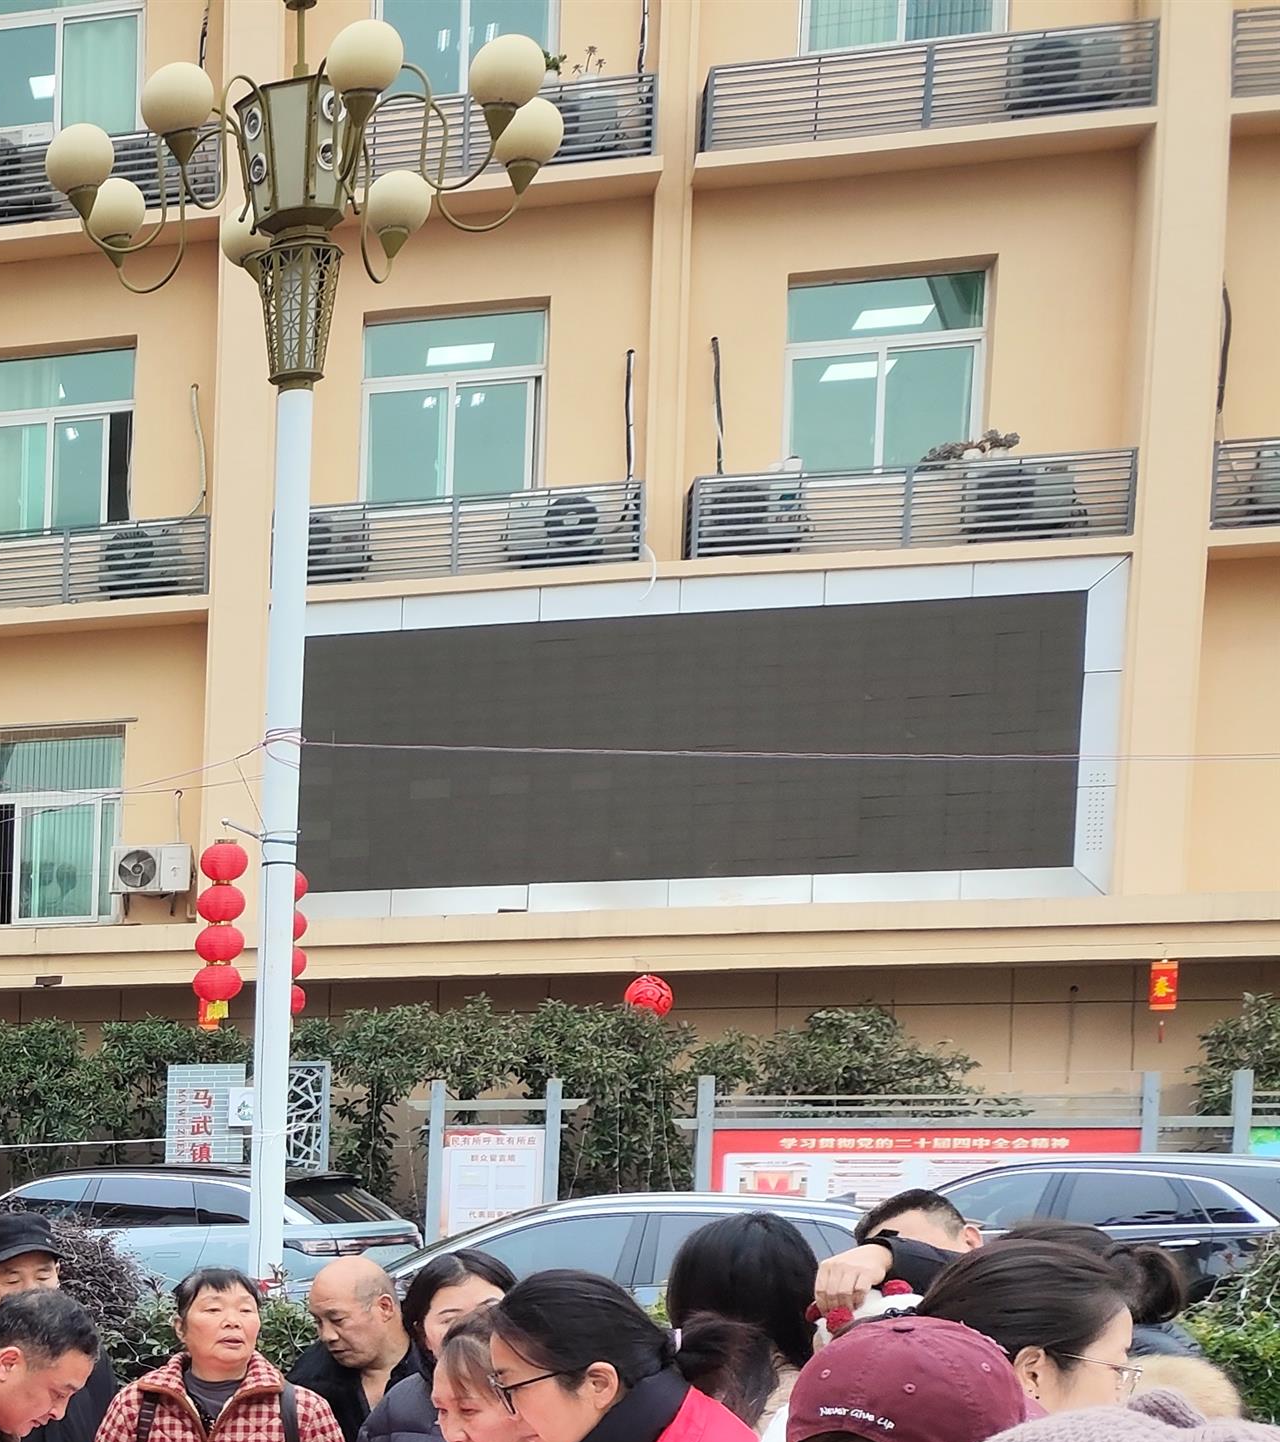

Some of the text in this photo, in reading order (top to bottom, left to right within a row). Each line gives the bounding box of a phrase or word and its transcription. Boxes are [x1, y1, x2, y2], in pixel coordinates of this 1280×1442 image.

[190, 1089, 213, 1163] 马武镇
[779, 1137, 1070, 1149] 学习贯彻党的二十届四中全会精神
